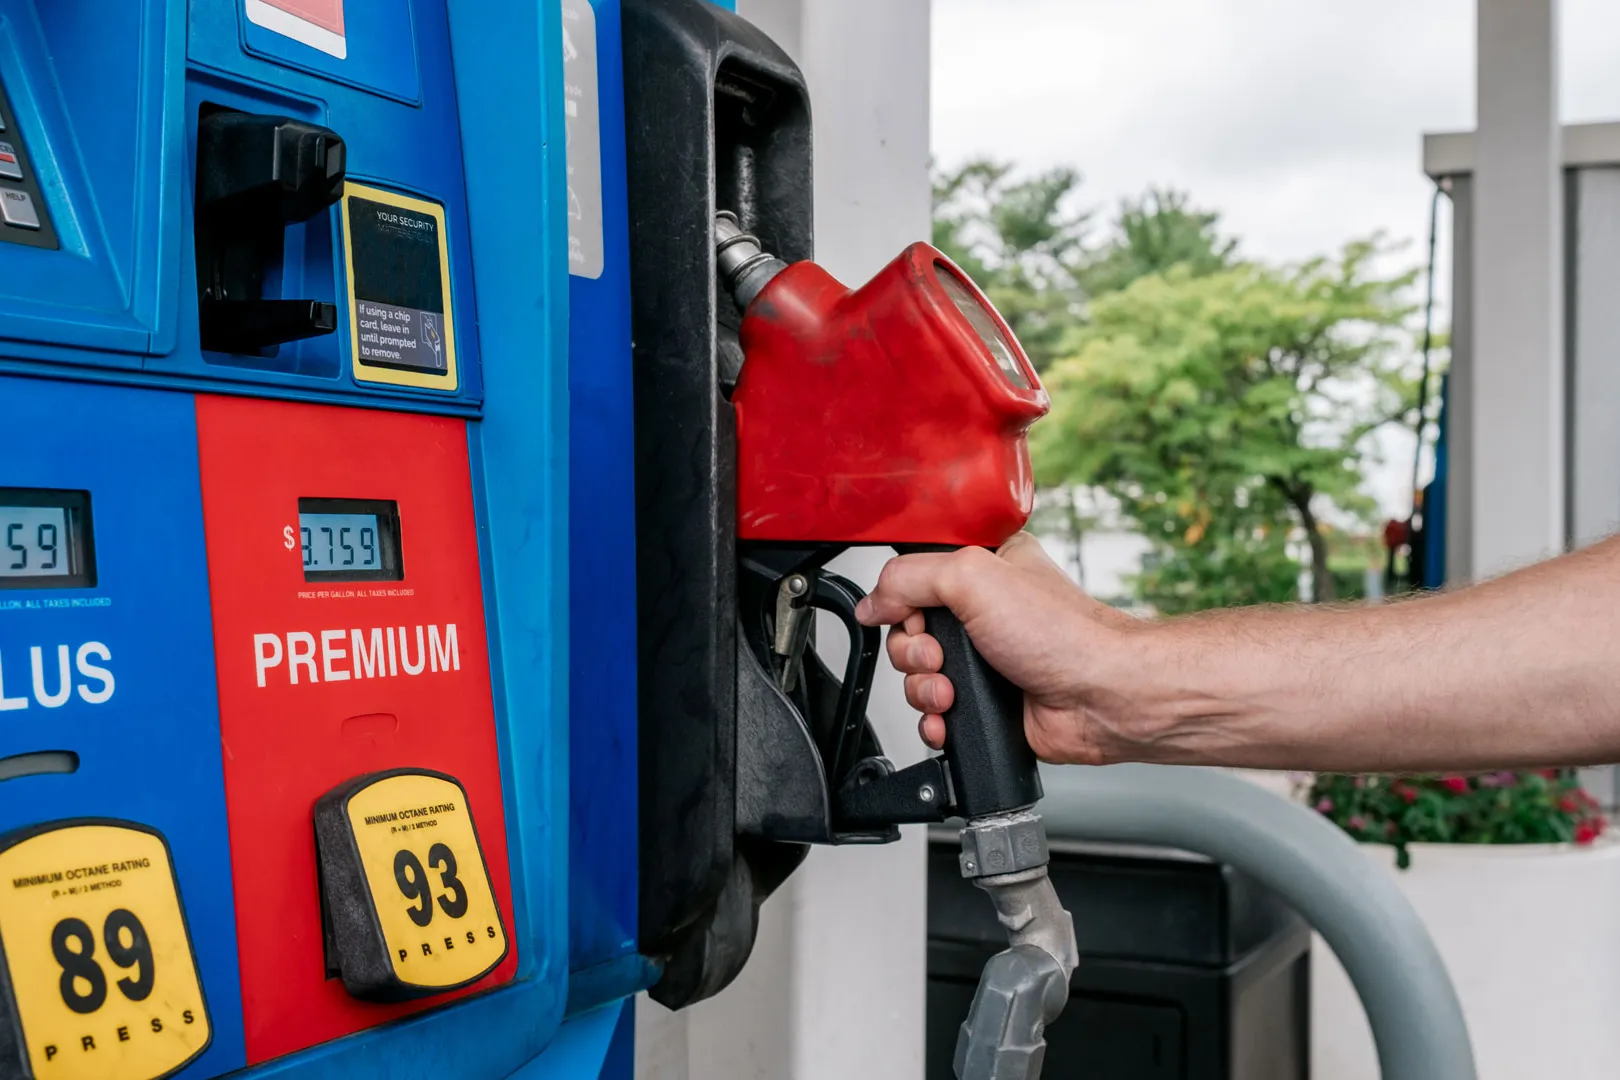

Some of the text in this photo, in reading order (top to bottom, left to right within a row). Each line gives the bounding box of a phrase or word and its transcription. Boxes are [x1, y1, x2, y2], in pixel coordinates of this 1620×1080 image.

[5, 192, 26, 201] HELP
[377, 210, 434, 232] YOUR SECURITY
[359, 304, 411, 323] If using a chip
[360, 320, 410, 334] card, leave in
[361, 333, 417, 349] until prompted
[362, 345, 402, 359] to remove.
[7, 523, 57, 570] 59
[25, 599, 41, 608] ALL
[44, 598, 70, 608] TAXES
[72, 597, 112, 607] INCLUDED
[298, 591, 316, 599] PRICE
[330, 590, 355, 598] GALLON
[253, 623, 461, 687] PREMIUM
[364, 803, 455, 826] MINIMUM OCTANE RATING
[416, 820, 437, 828] METHOD
[13, 858, 151, 888] MINIMUM OCTANE RATING
[90, 879, 122, 891] METHOD
[393, 842, 469, 927] 93
[398, 926, 496, 962] PRESS
[51, 908, 155, 1014] 89
[44, 1010, 195, 1061] PRESS
